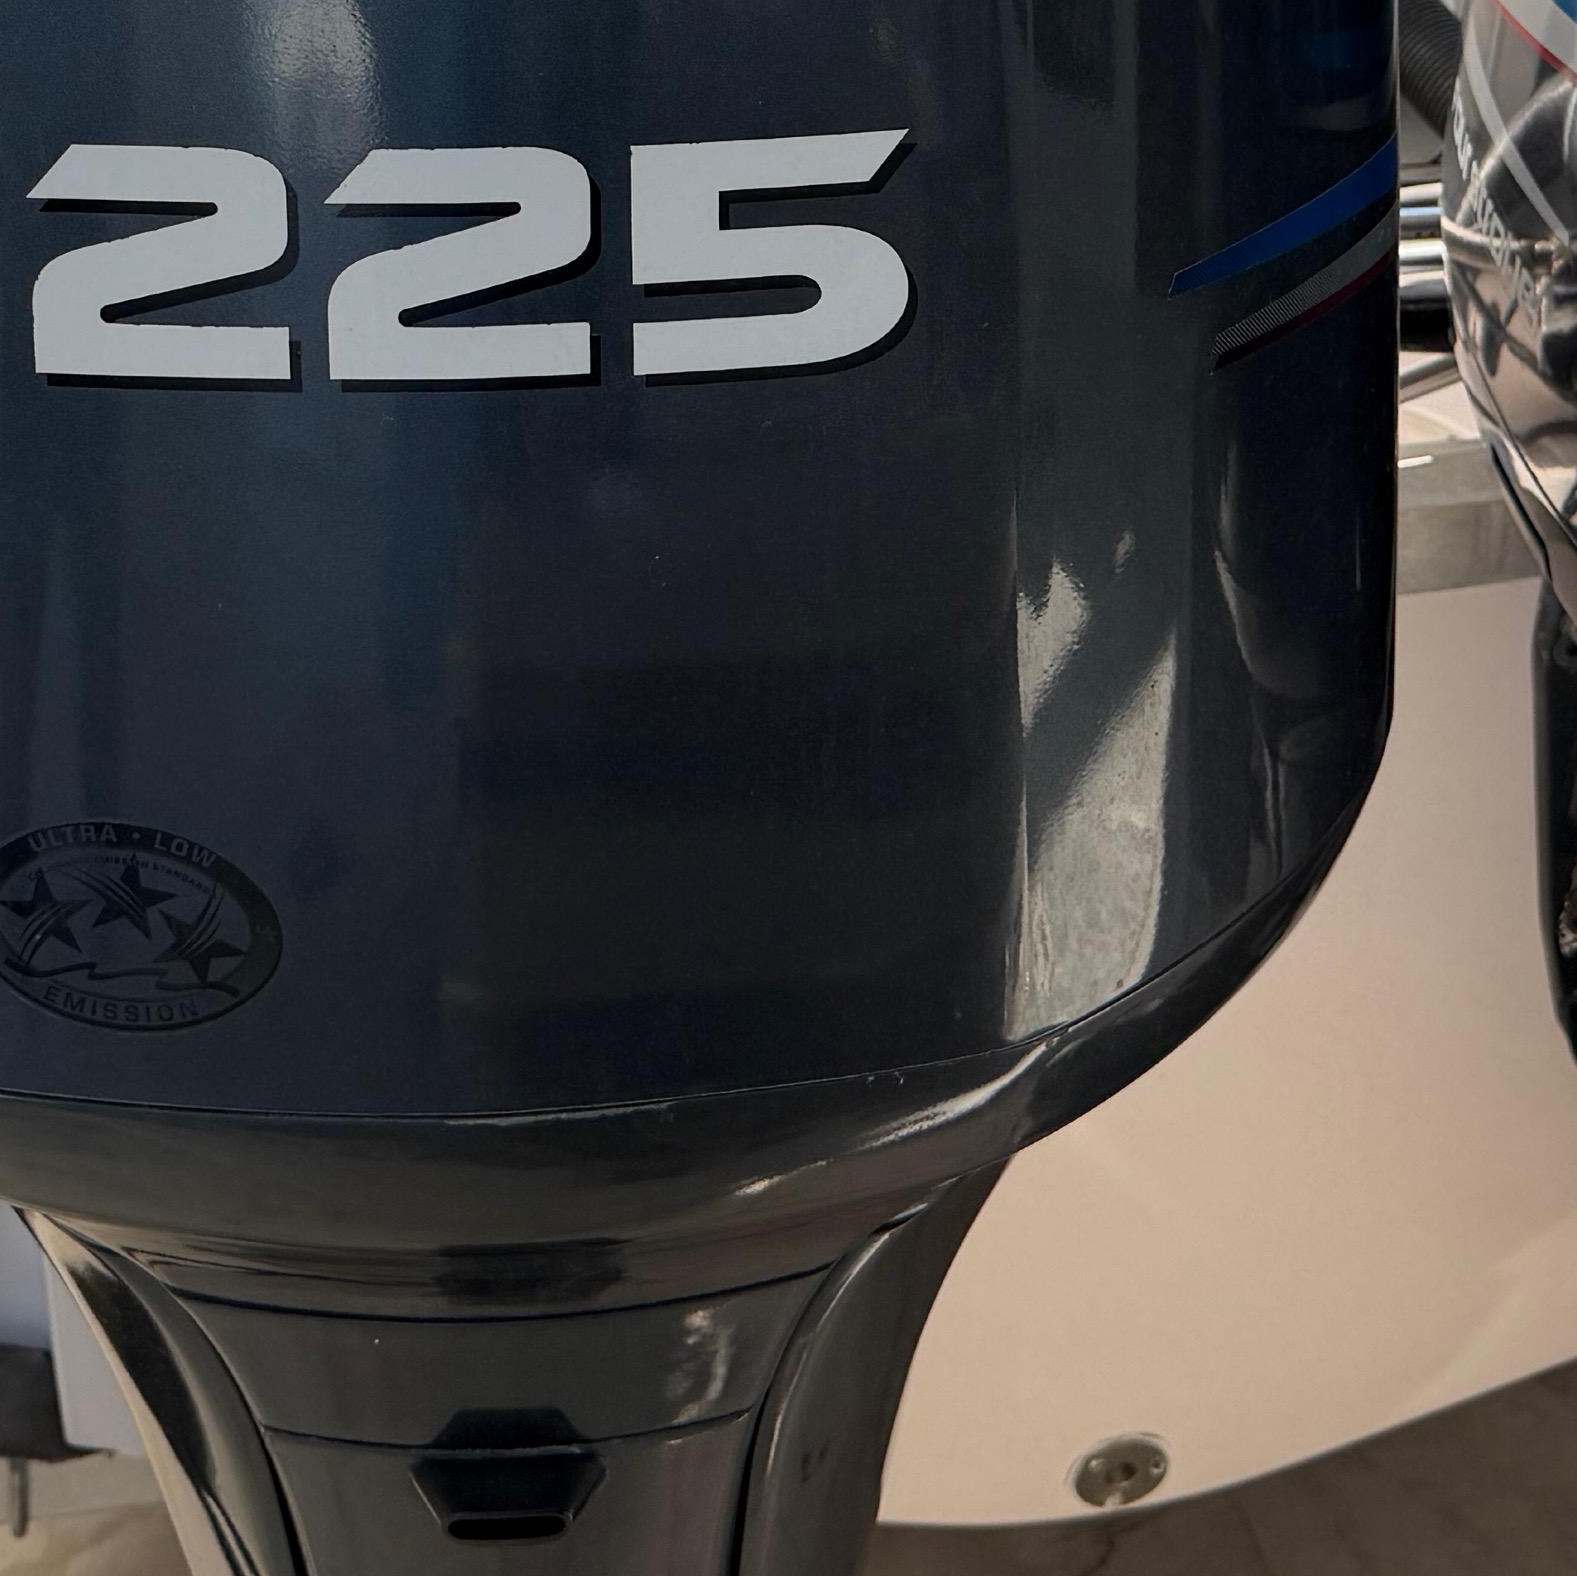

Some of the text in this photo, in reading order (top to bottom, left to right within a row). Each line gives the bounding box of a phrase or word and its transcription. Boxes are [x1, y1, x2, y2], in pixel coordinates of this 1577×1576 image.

[25, 128, 914, 385] 225
[26, 823, 218, 869] ULTRA LOW
[43, 983, 202, 1024] EMISSION
